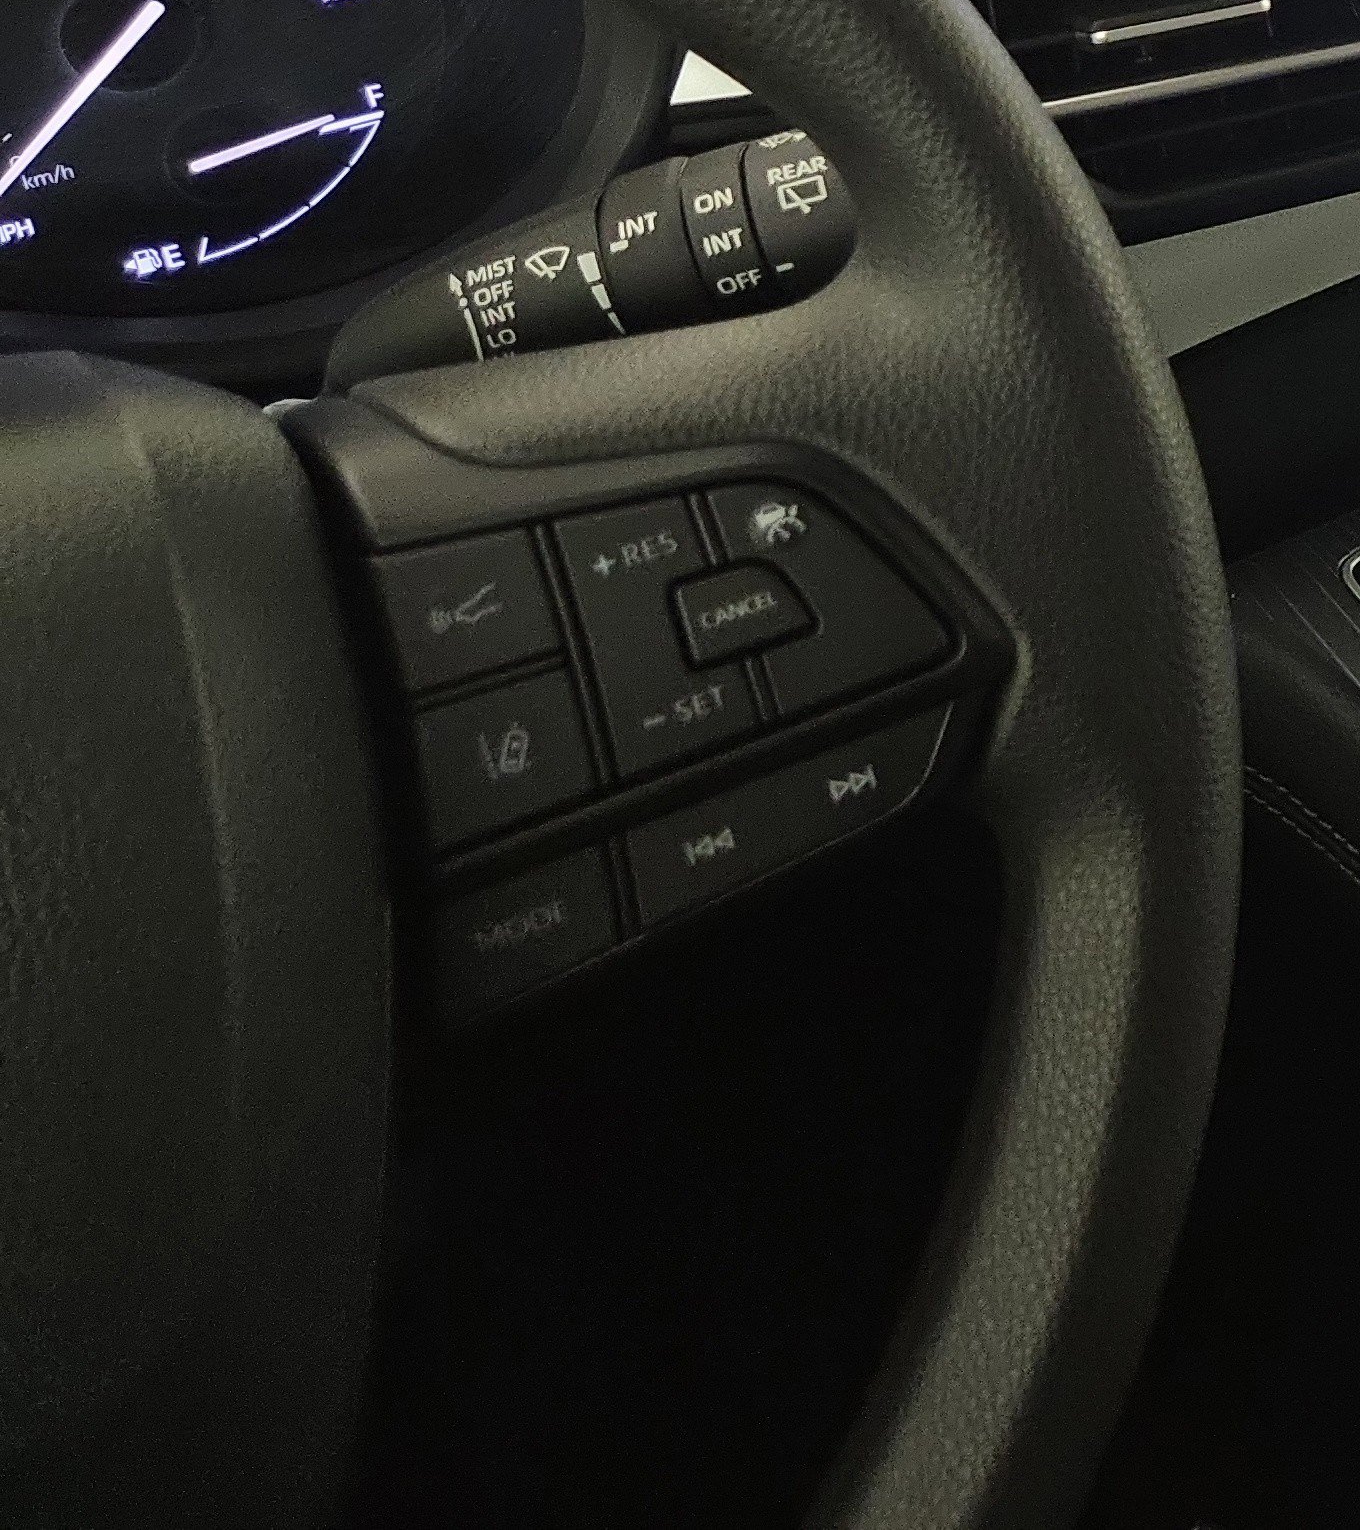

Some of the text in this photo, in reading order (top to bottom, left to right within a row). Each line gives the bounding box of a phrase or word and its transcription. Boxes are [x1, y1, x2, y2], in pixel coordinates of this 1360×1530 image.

[364, 83, 384, 108] F
[21, 164, 75, 190] km/h
[767, 155, 829, 185] REAR
[694, 186, 735, 215] ON
[618, 211, 658, 240] INT
[164, 243, 186, 270] E
[702, 228, 744, 257] INT
[467, 255, 515, 286] MIST
[717, 269, 761, 295] OFF
[474, 280, 513, 306] OFF
[480, 301, 515, 327] INT
[487, 329, 516, 348] LO
[621, 530, 678, 569] RES
[702, 592, 777, 630] CANCEL
[674, 685, 726, 725] SET
